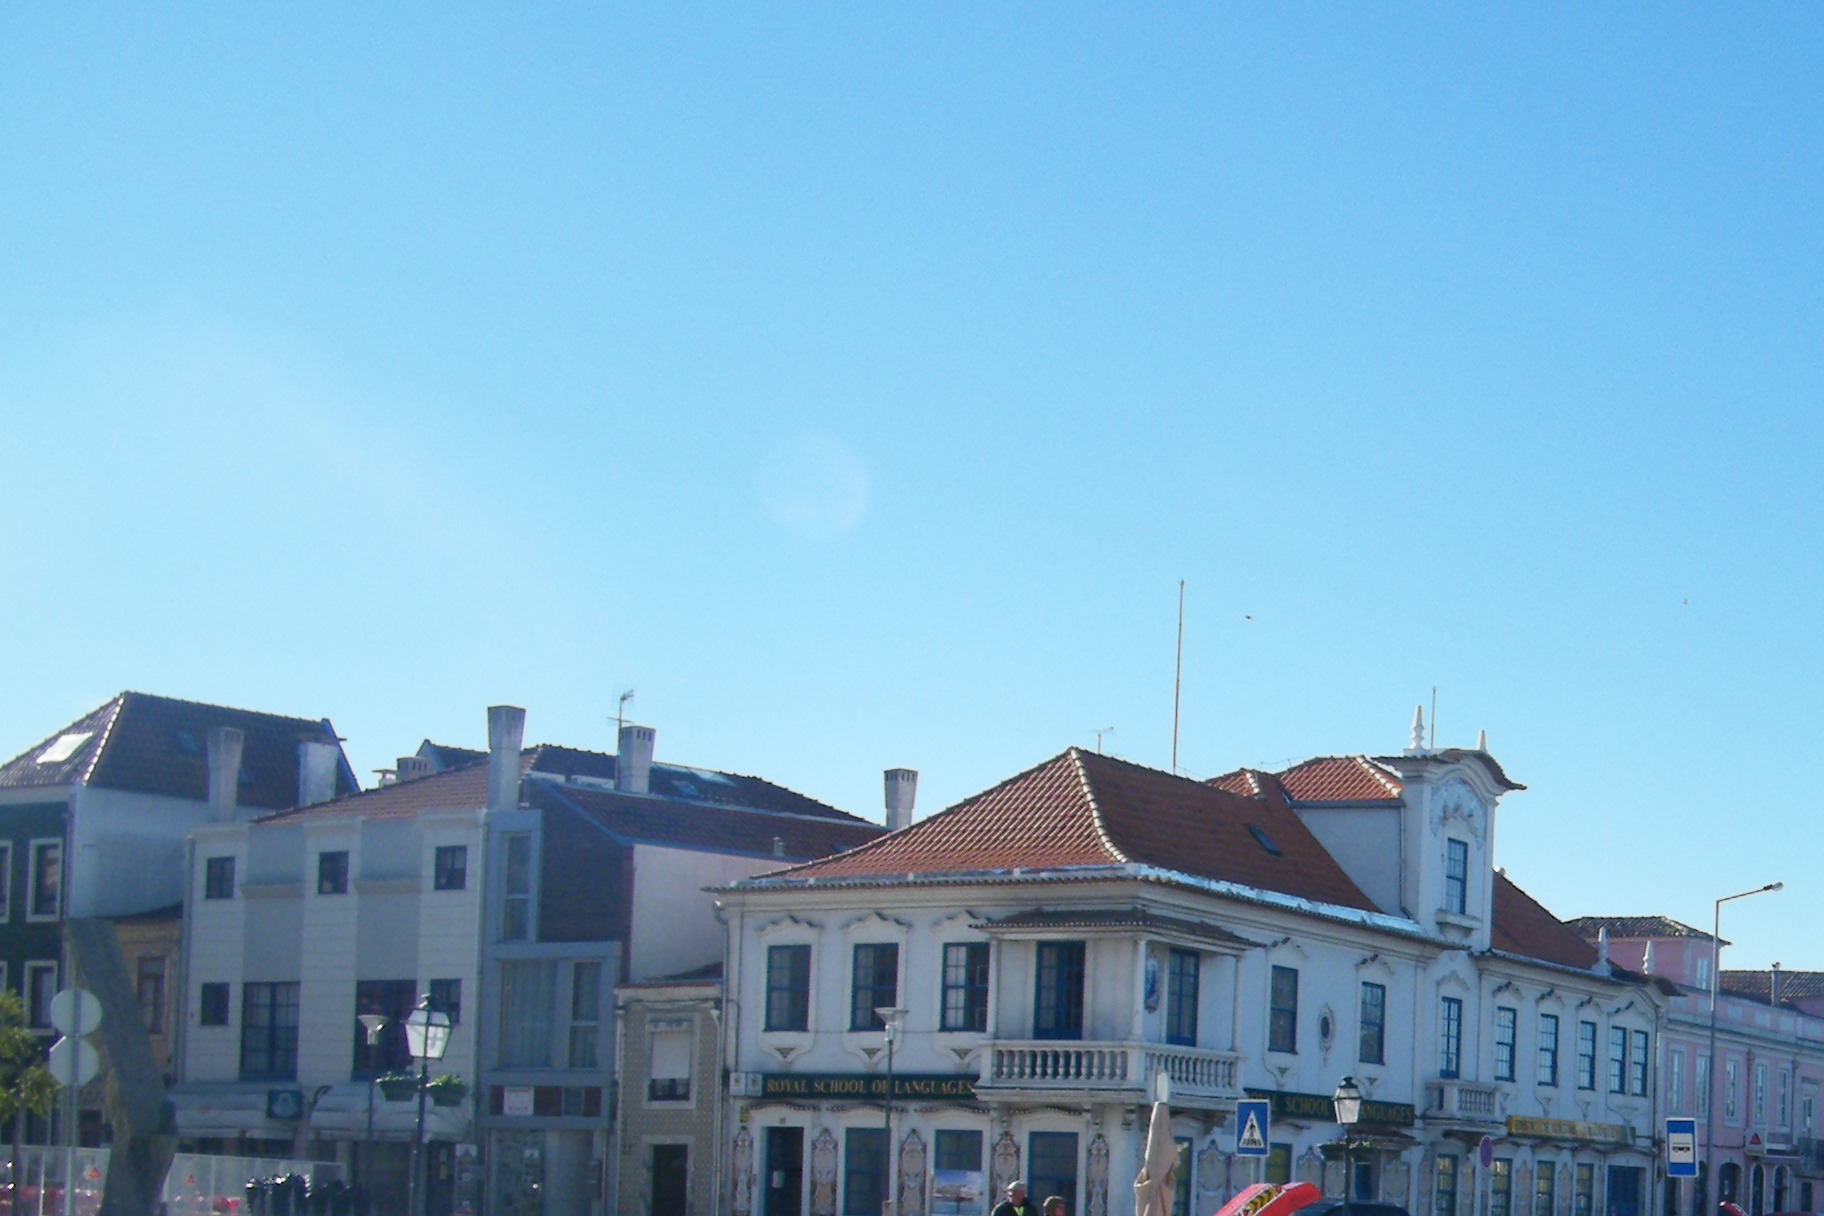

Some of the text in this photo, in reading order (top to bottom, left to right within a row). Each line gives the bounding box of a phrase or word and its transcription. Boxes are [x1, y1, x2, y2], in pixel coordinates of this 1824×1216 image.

[767, 1079, 808, 1094] ROYAL
[813, 1079, 867, 1094] SCHOOL
[895, 1079, 973, 1095] LANGUAGES
[1285, 1095, 1330, 1116] SCHOOL
